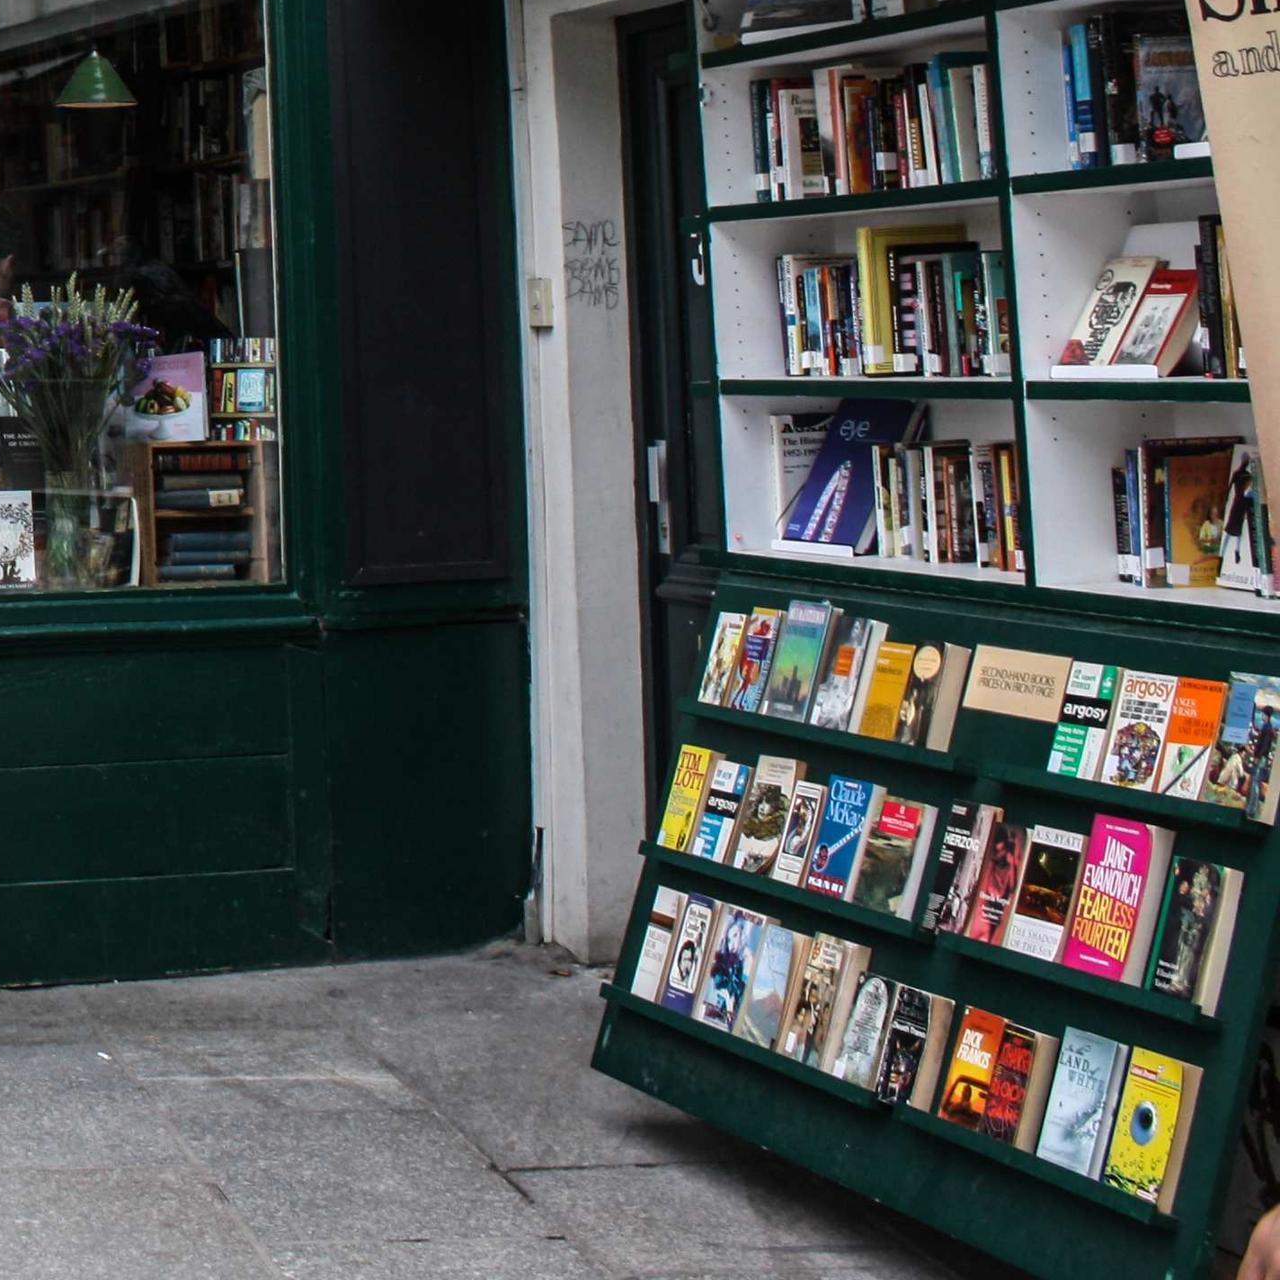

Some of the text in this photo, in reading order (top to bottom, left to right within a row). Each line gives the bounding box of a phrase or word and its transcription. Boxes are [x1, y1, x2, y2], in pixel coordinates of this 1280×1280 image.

[1124, 678, 1175, 702] argosy
[1063, 701, 1109, 722] argosy
[680, 751, 703, 771] TIM
[675, 767, 705, 790] LOTT
[708, 795, 739, 813] argosy
[831, 779, 866, 806] Claude
[825, 800, 865, 832] McKay
[943, 831, 981, 853] HERZOG
[1099, 835, 1136, 873] JANET
[1082, 863, 1143, 908] EVANOVICH
[1076, 884, 1135, 930] FEARLESS
[1071, 917, 1131, 963] FOURTEEN
[962, 1028, 985, 1050] DICK
[1059, 1051, 1090, 1074] LAND
